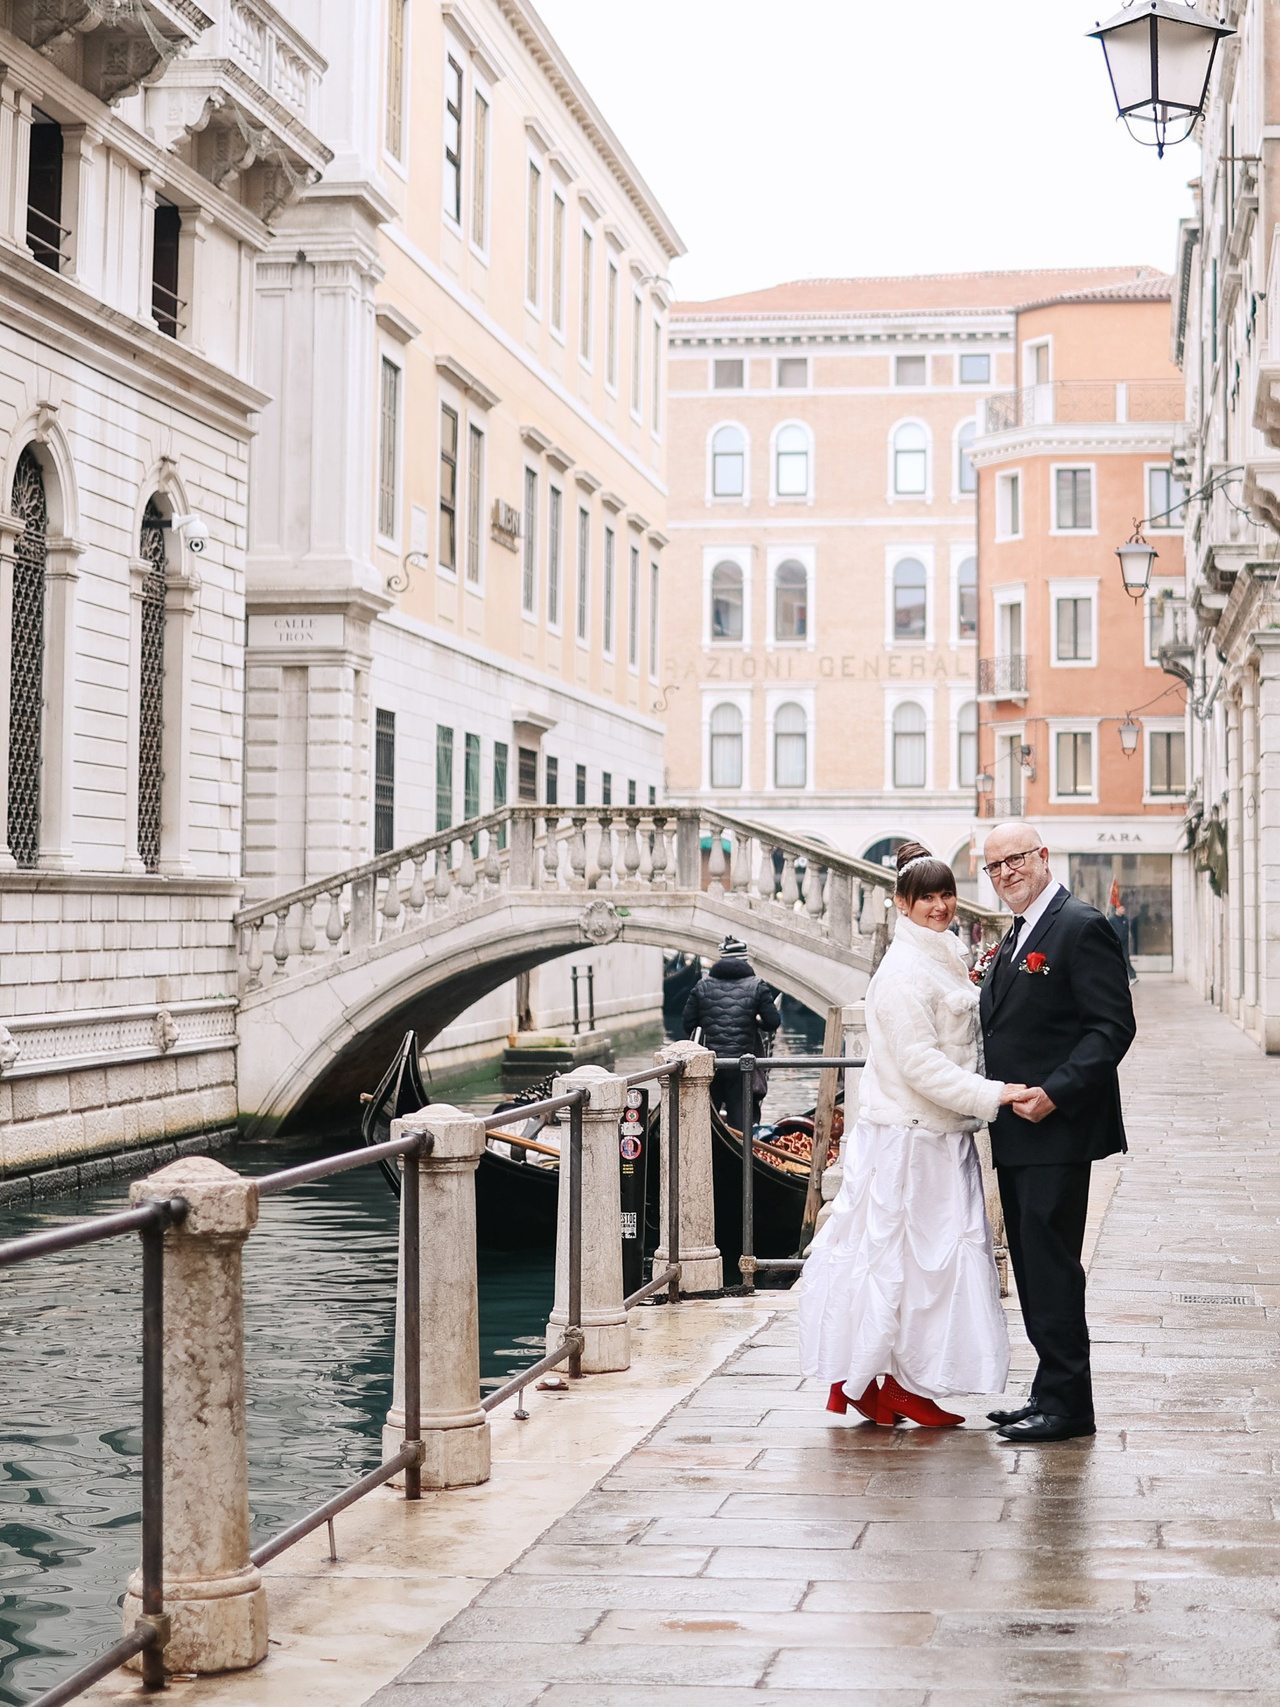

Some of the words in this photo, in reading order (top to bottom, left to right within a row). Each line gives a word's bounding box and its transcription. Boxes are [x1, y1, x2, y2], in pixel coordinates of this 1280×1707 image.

[273, 619, 317, 629] CALLE
[278, 632, 314, 642] TRON
[1097, 833, 1143, 842] ZARA
